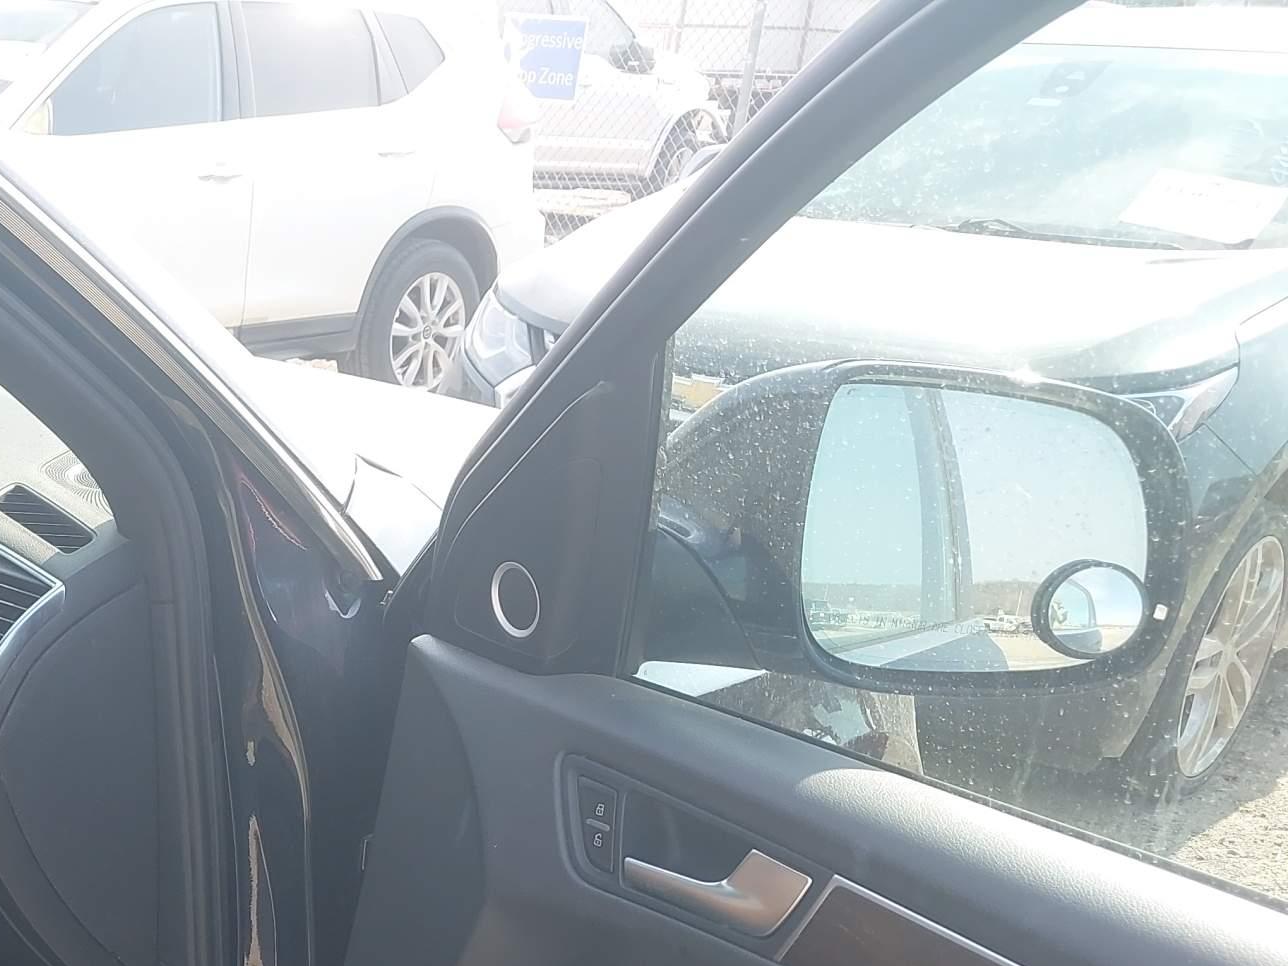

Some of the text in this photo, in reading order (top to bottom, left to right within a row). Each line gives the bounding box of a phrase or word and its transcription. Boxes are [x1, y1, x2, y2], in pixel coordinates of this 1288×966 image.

[519, 32, 583, 50] ogressive
[518, 66, 574, 86] op Zone
